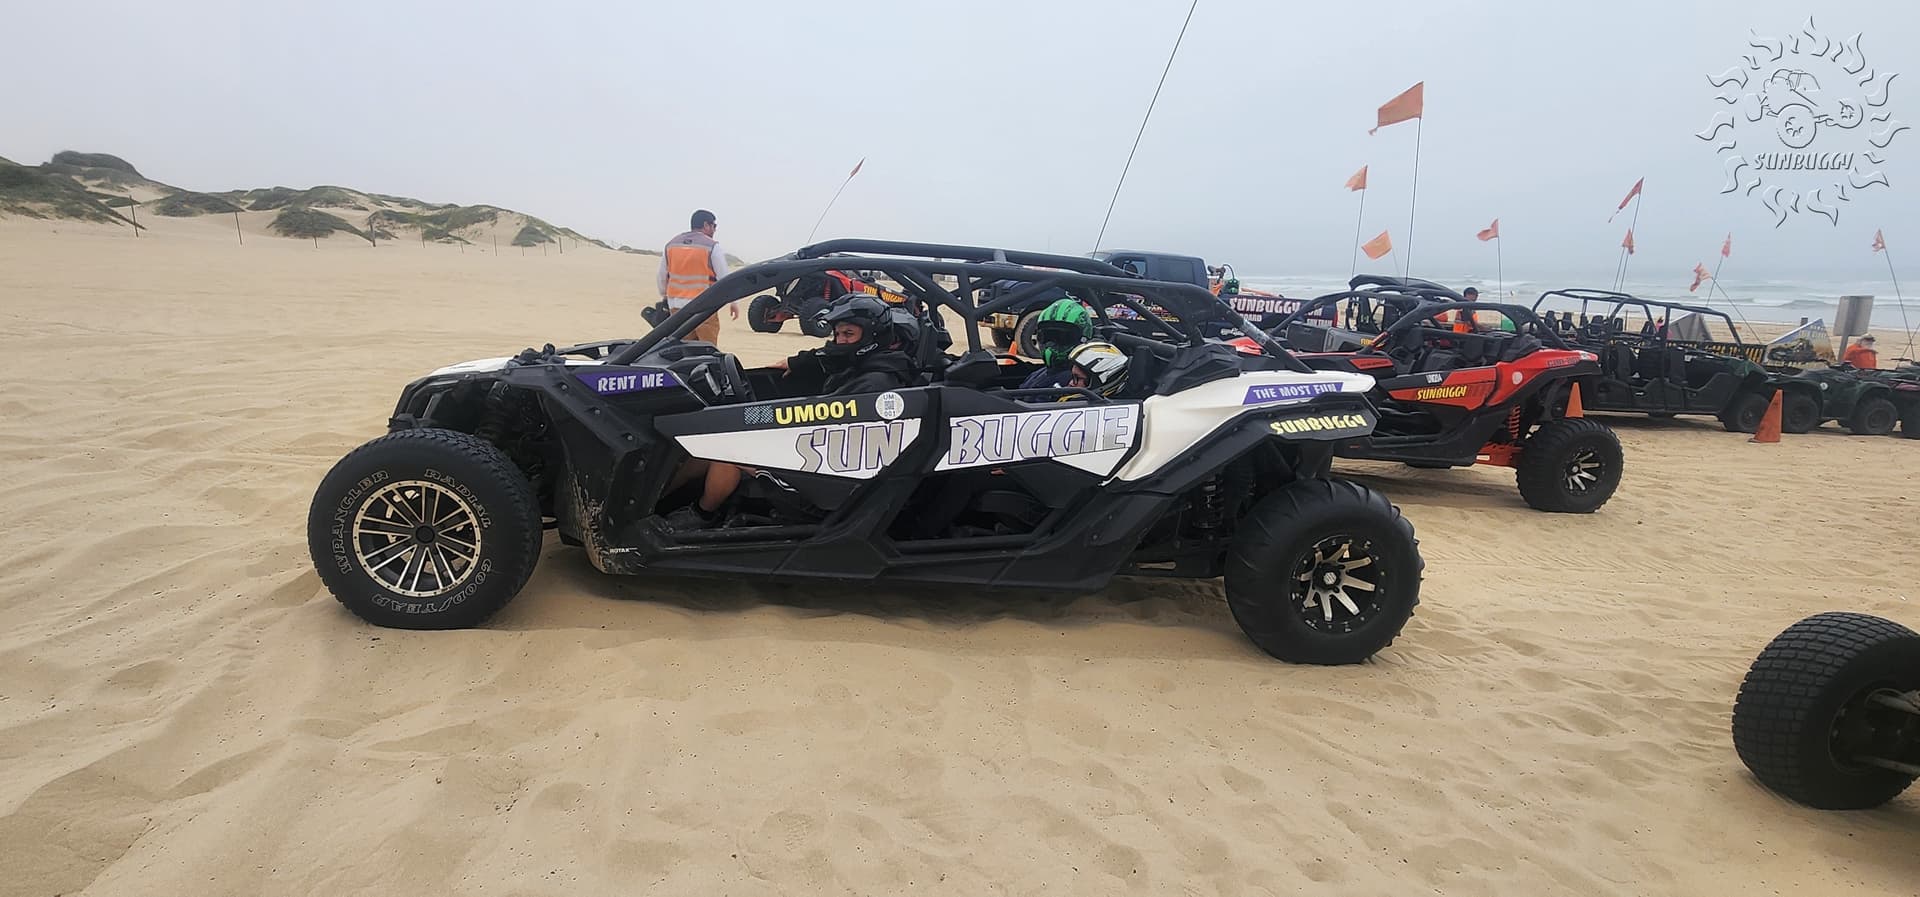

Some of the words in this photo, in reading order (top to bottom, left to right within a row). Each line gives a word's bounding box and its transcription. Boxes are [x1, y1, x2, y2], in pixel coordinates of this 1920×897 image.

[1229, 297, 1302, 314] SUNBUGGY
[597, 375, 636, 392] RENT
[642, 373, 664, 388] ME
[1253, 388, 1277, 399] THE
[1280, 386, 1312, 397] MOST
[1313, 383, 1337, 394] FUN
[1417, 385, 1468, 401] SUNBUGGY
[775, 400, 858, 425] UM001
[1270, 414, 1368, 435] SUNBUGGY
[796, 422, 904, 473] SUN
[948, 407, 1130, 465] BUGGIE
[424, 469, 492, 529] RADIAL
[331, 470, 389, 575] WRANGLER
